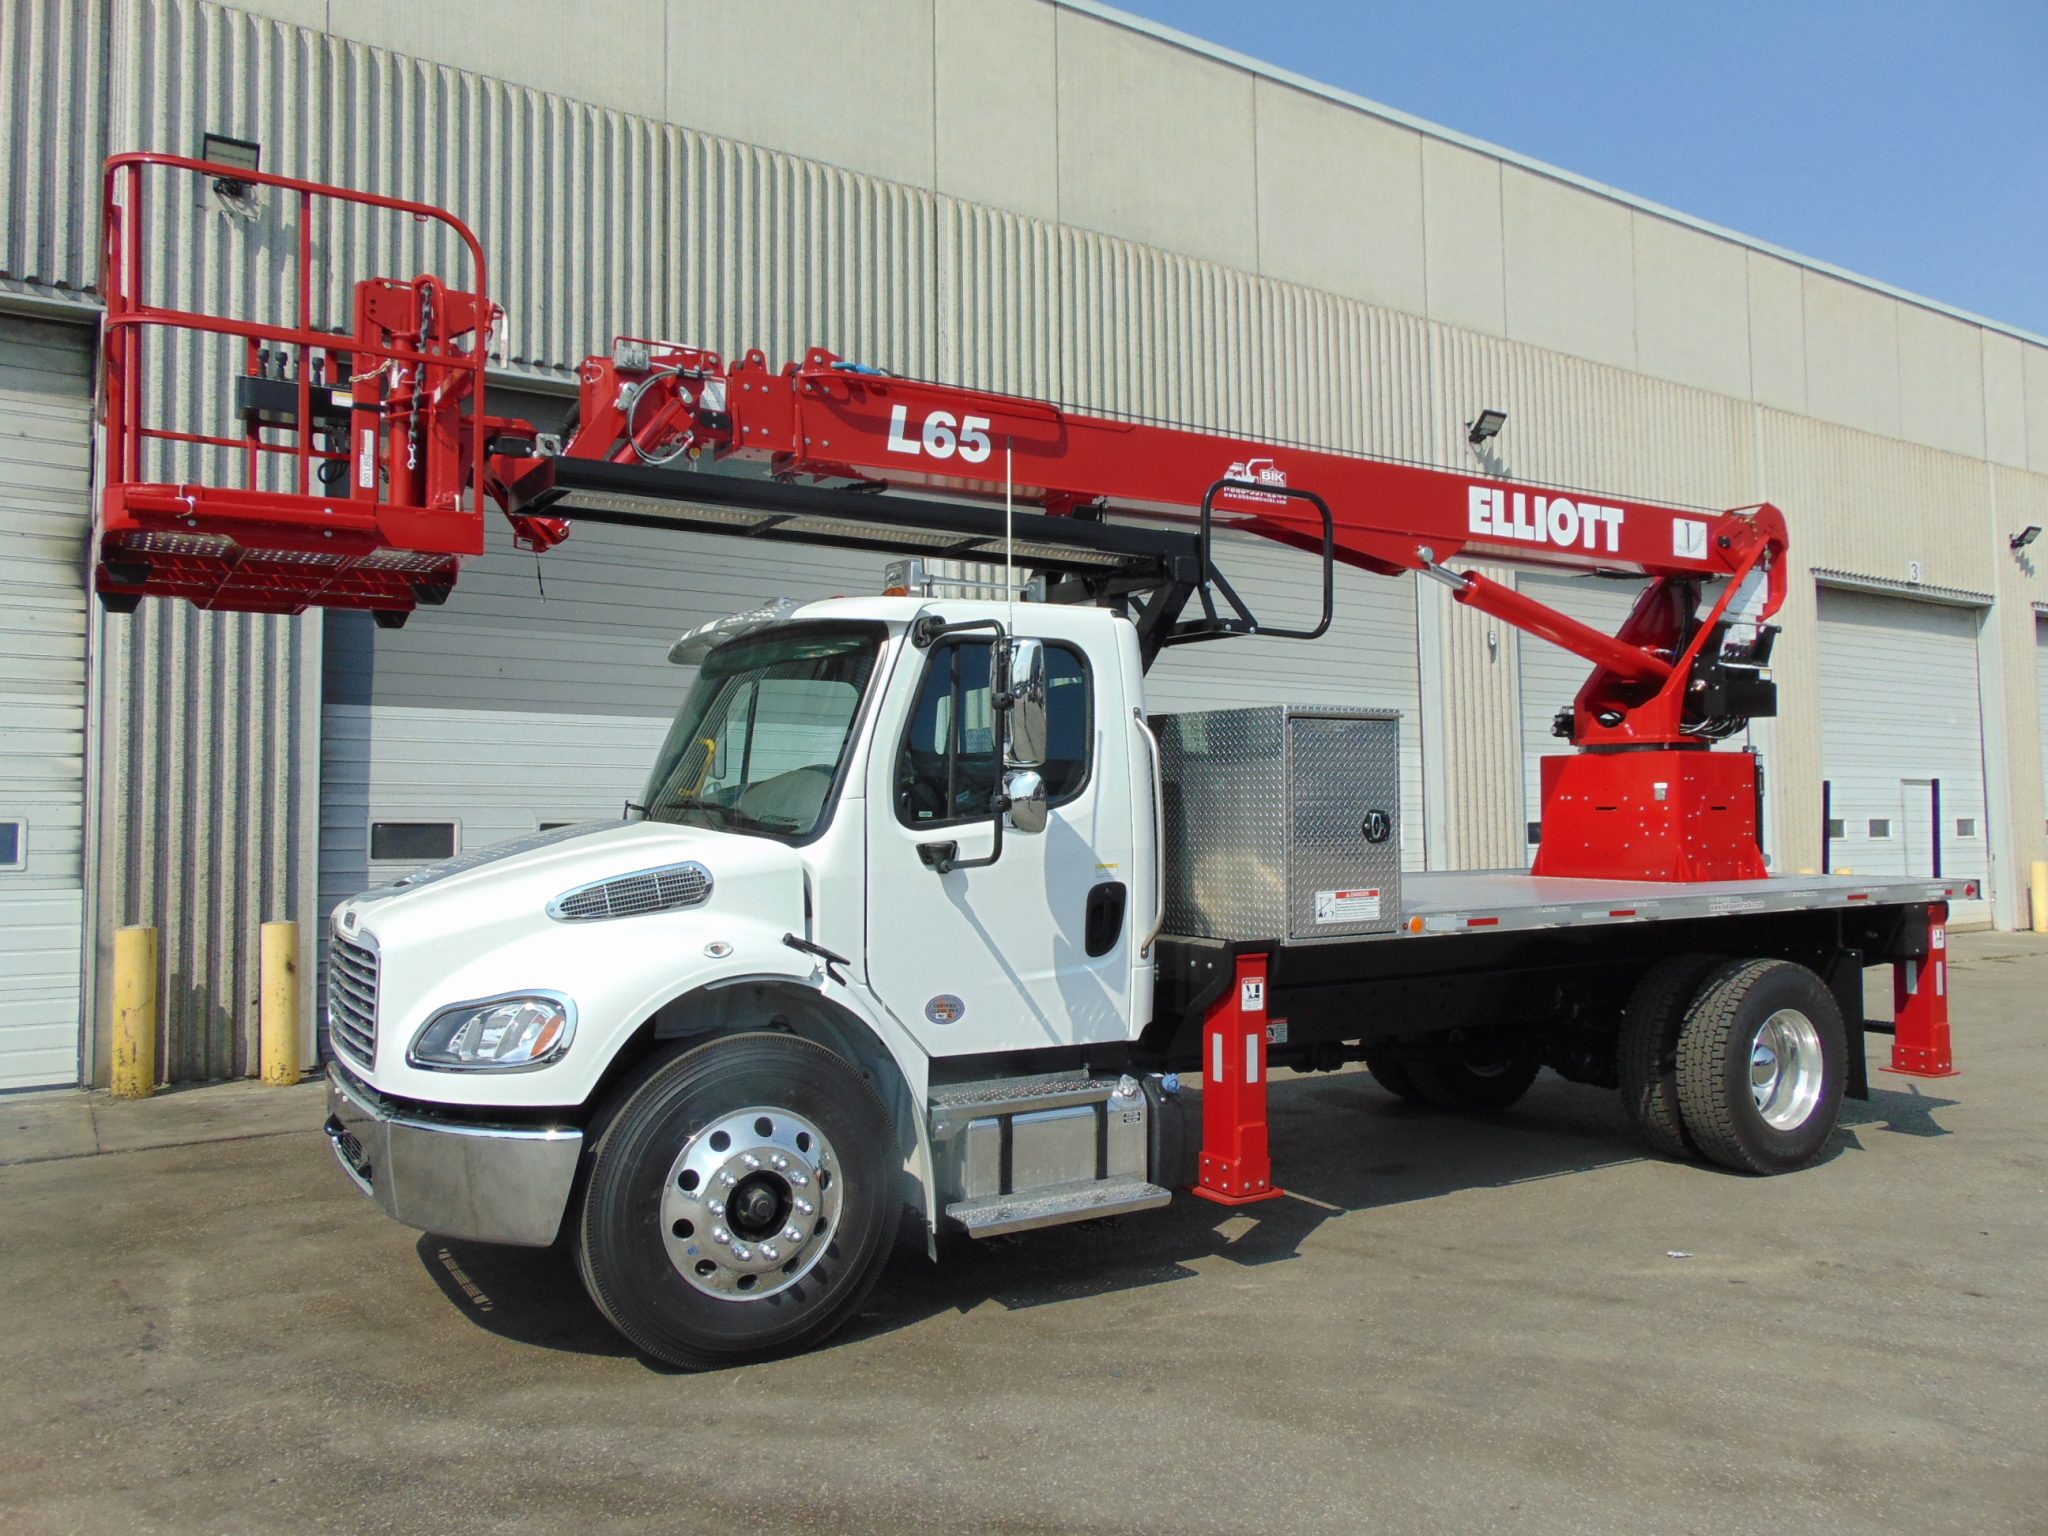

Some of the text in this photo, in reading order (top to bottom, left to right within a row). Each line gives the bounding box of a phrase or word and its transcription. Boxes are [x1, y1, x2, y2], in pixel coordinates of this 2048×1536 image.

[887, 404, 991, 463] L65
[1261, 471, 1284, 482] BIK
[1468, 486, 1624, 552] ELLIOTT
[1911, 563, 1918, 581] 3
